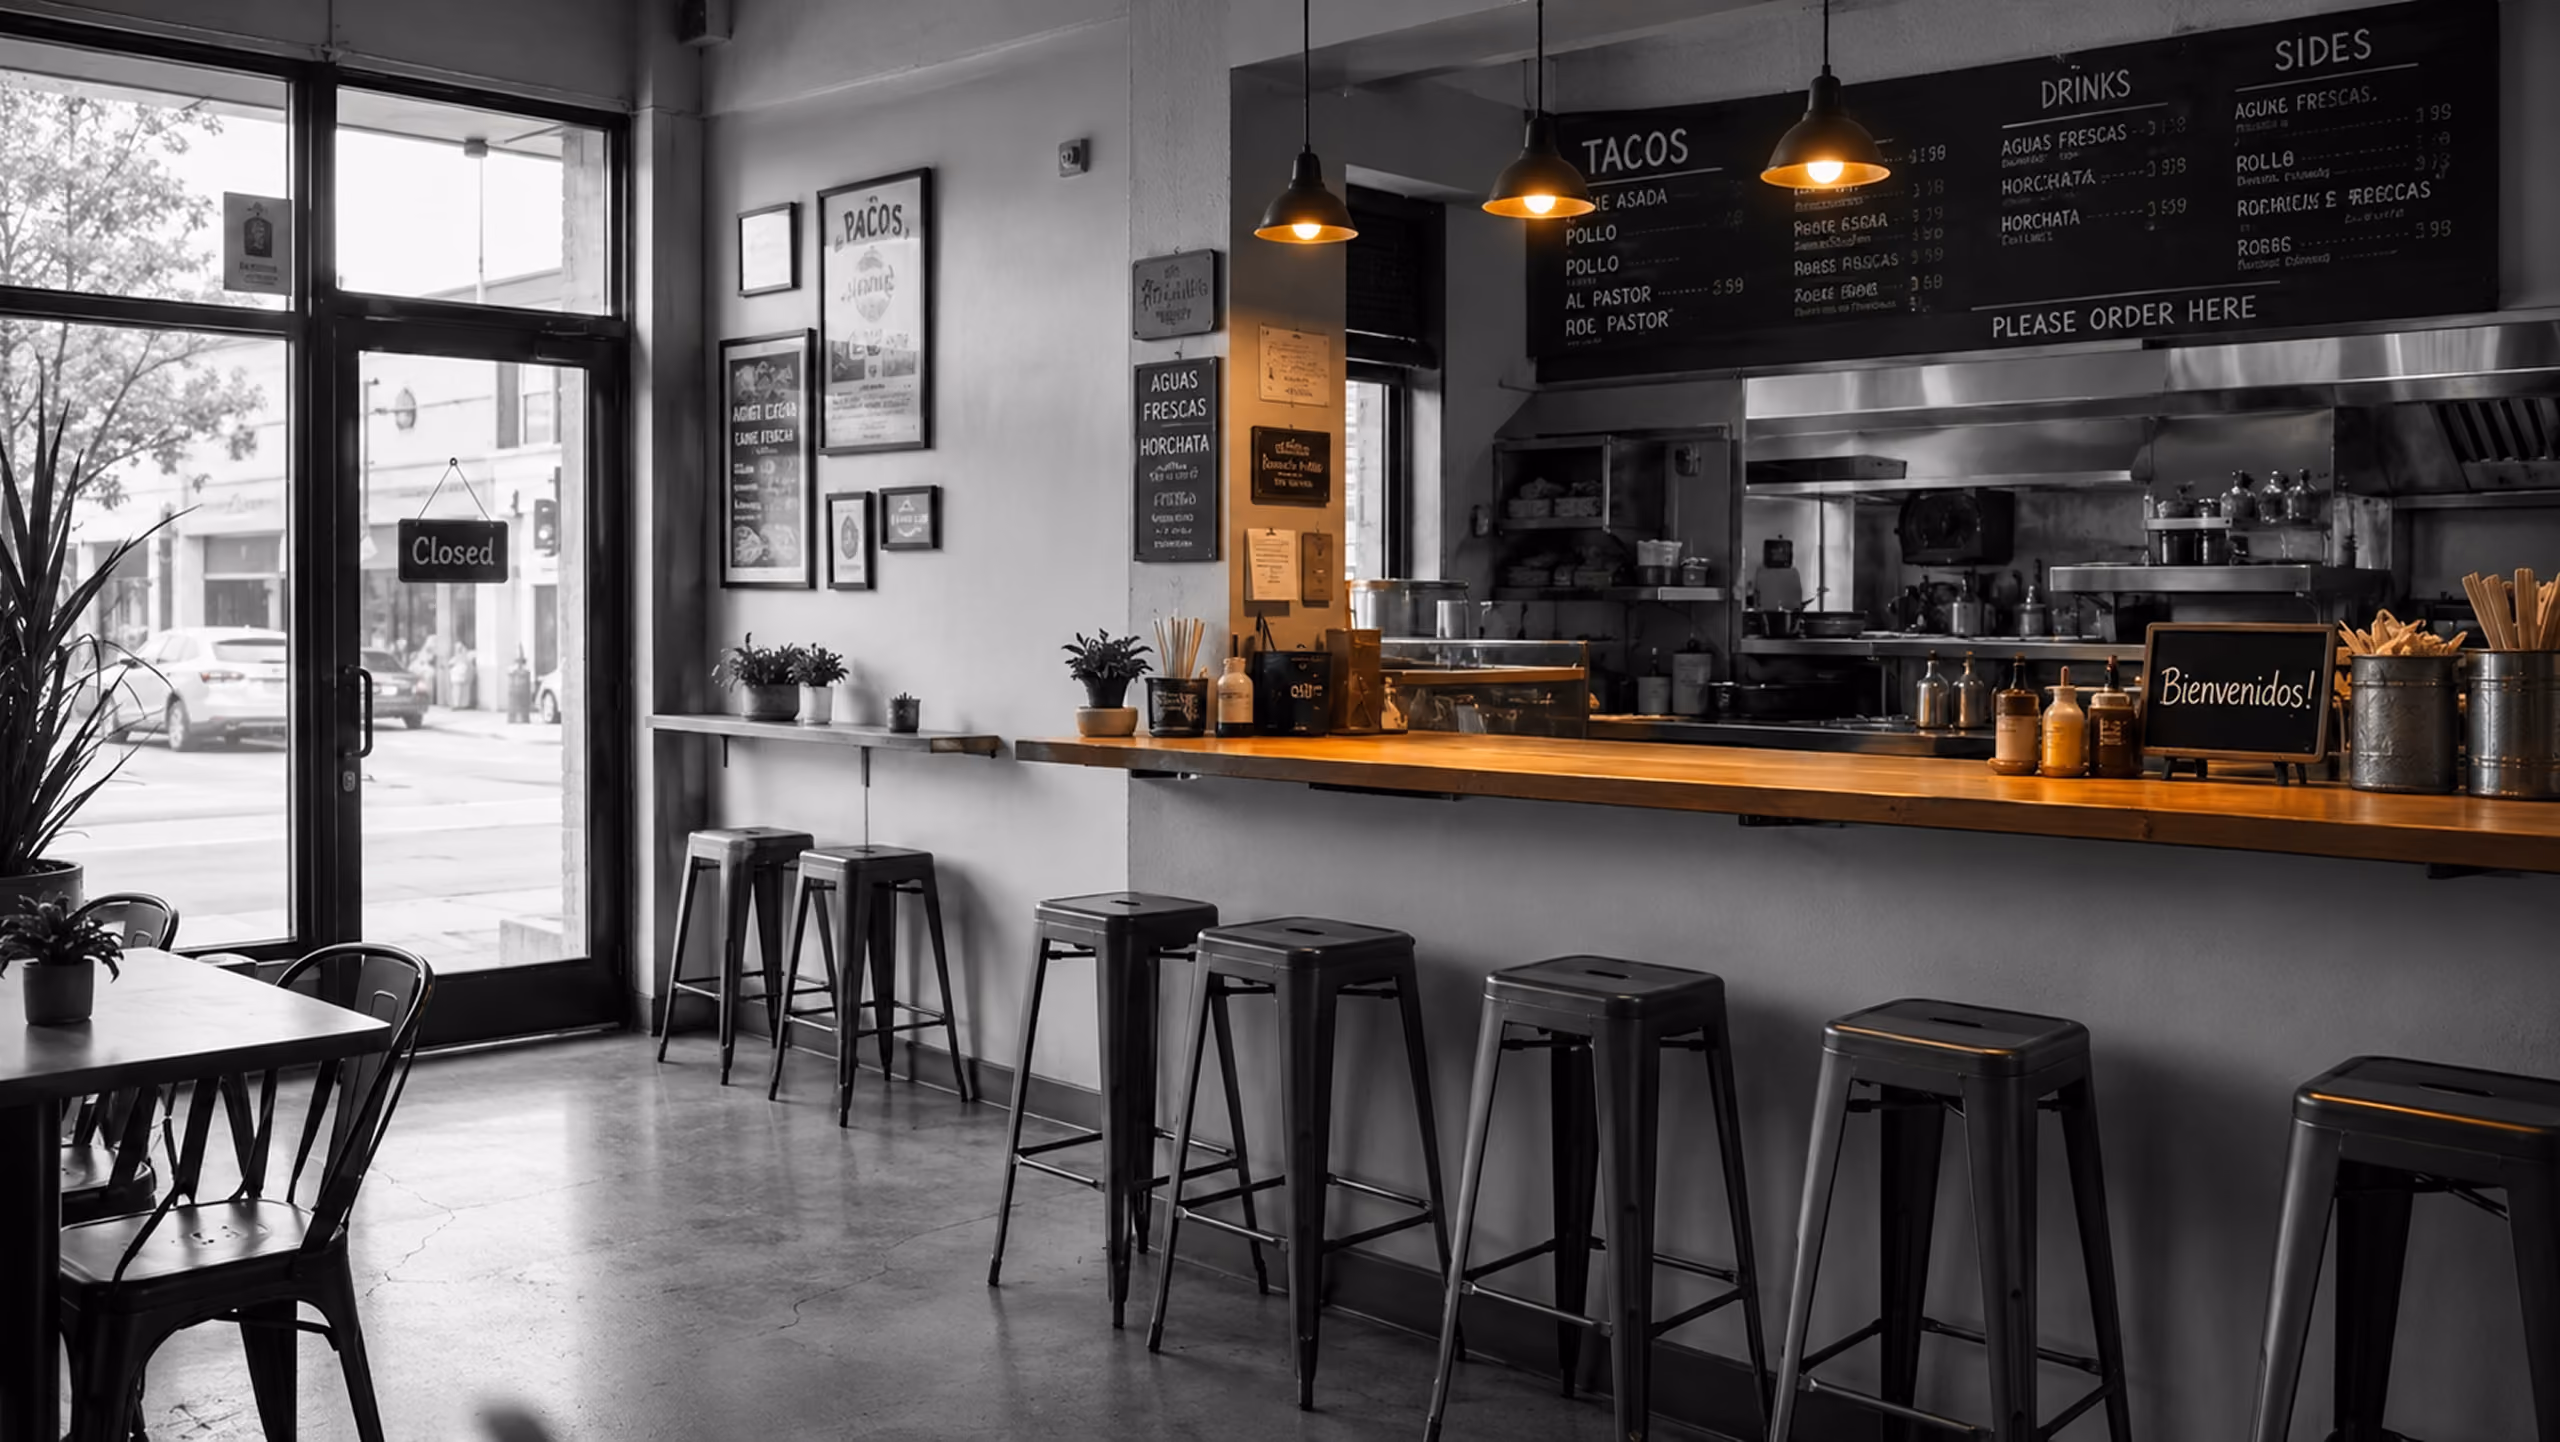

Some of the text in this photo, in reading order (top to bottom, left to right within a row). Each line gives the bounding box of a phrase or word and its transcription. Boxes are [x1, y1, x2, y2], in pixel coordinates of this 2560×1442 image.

[2274, 28, 2372, 71] SIDES
[2041, 69, 2132, 110] DRINKS
[1581, 128, 1689, 175] TACOS
[2001, 134, 2052, 158] AGUAS
[2058, 123, 2128, 150] FRESCAS
[1616, 187, 1669, 209] ASADA
[2001, 208, 2081, 233] HORCHATA
[1566, 224, 1618, 247] POLLO
[1566, 255, 1619, 276] POLLO
[1565, 285, 1652, 310] AL PASTOR
[1992, 295, 2257, 338] PLEASE ORDER HERE
[1150, 370, 1199, 393] AGUAS
[1143, 398, 1207, 421] FRESCAS
[1140, 434, 1210, 457] HORCHATA
[412, 535, 495, 566] Closed
[2159, 666, 2316, 710] Bienvenidos!
